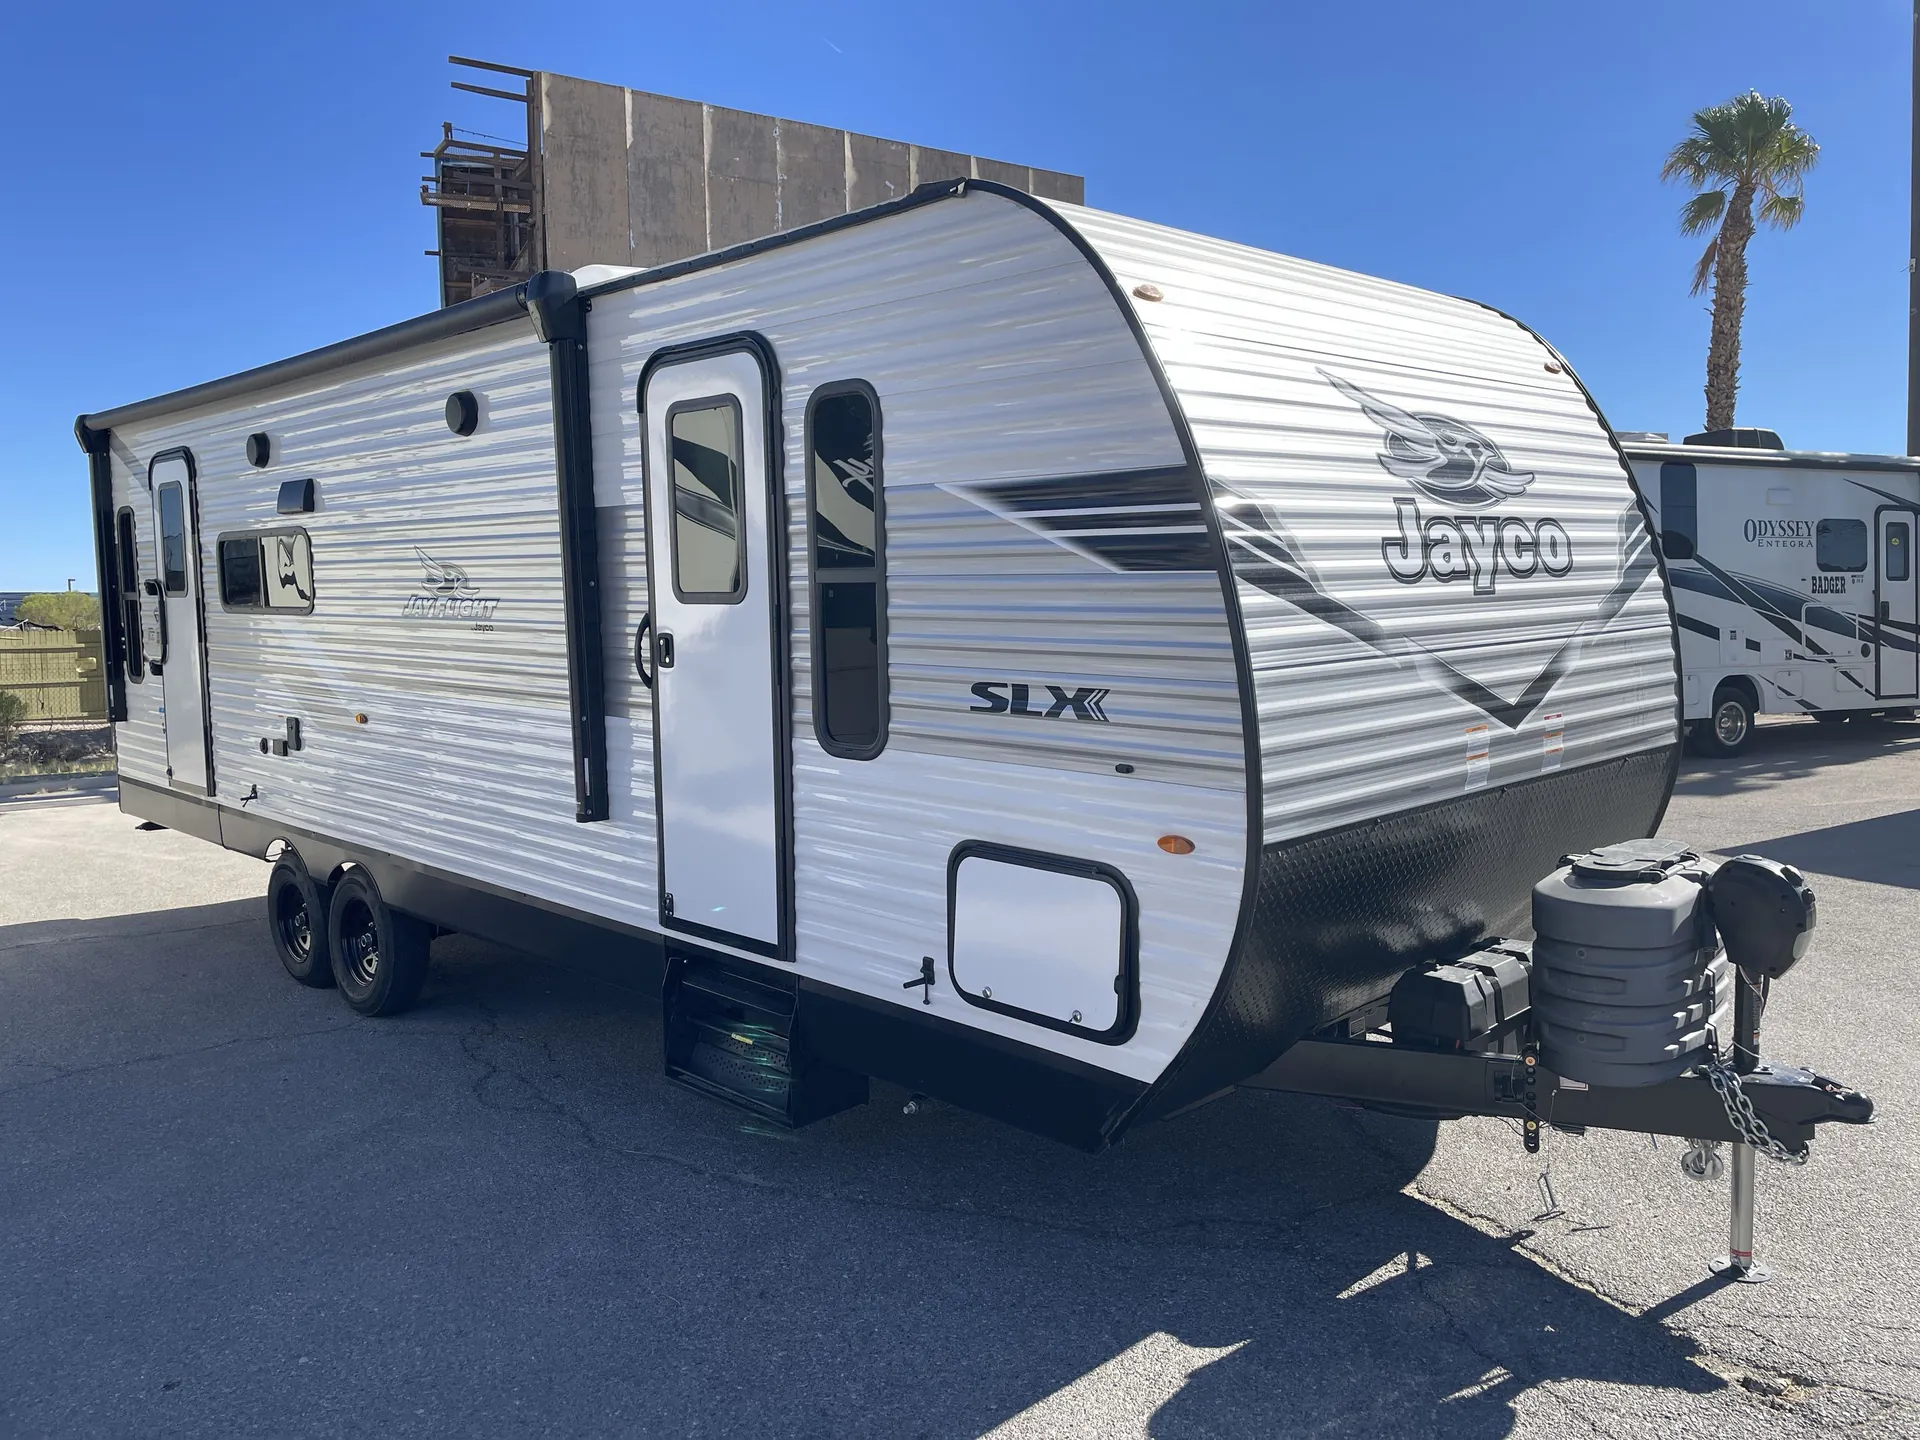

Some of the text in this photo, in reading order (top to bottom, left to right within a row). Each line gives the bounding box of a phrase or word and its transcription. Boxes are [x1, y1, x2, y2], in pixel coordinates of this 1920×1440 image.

[1744, 519, 1814, 542] ODYSSEY
[1381, 497, 1573, 596] Jayco
[1757, 539, 1814, 548] ENTEGRA
[1811, 576, 1846, 594] BADGER
[970, 682, 1110, 722] SLX
